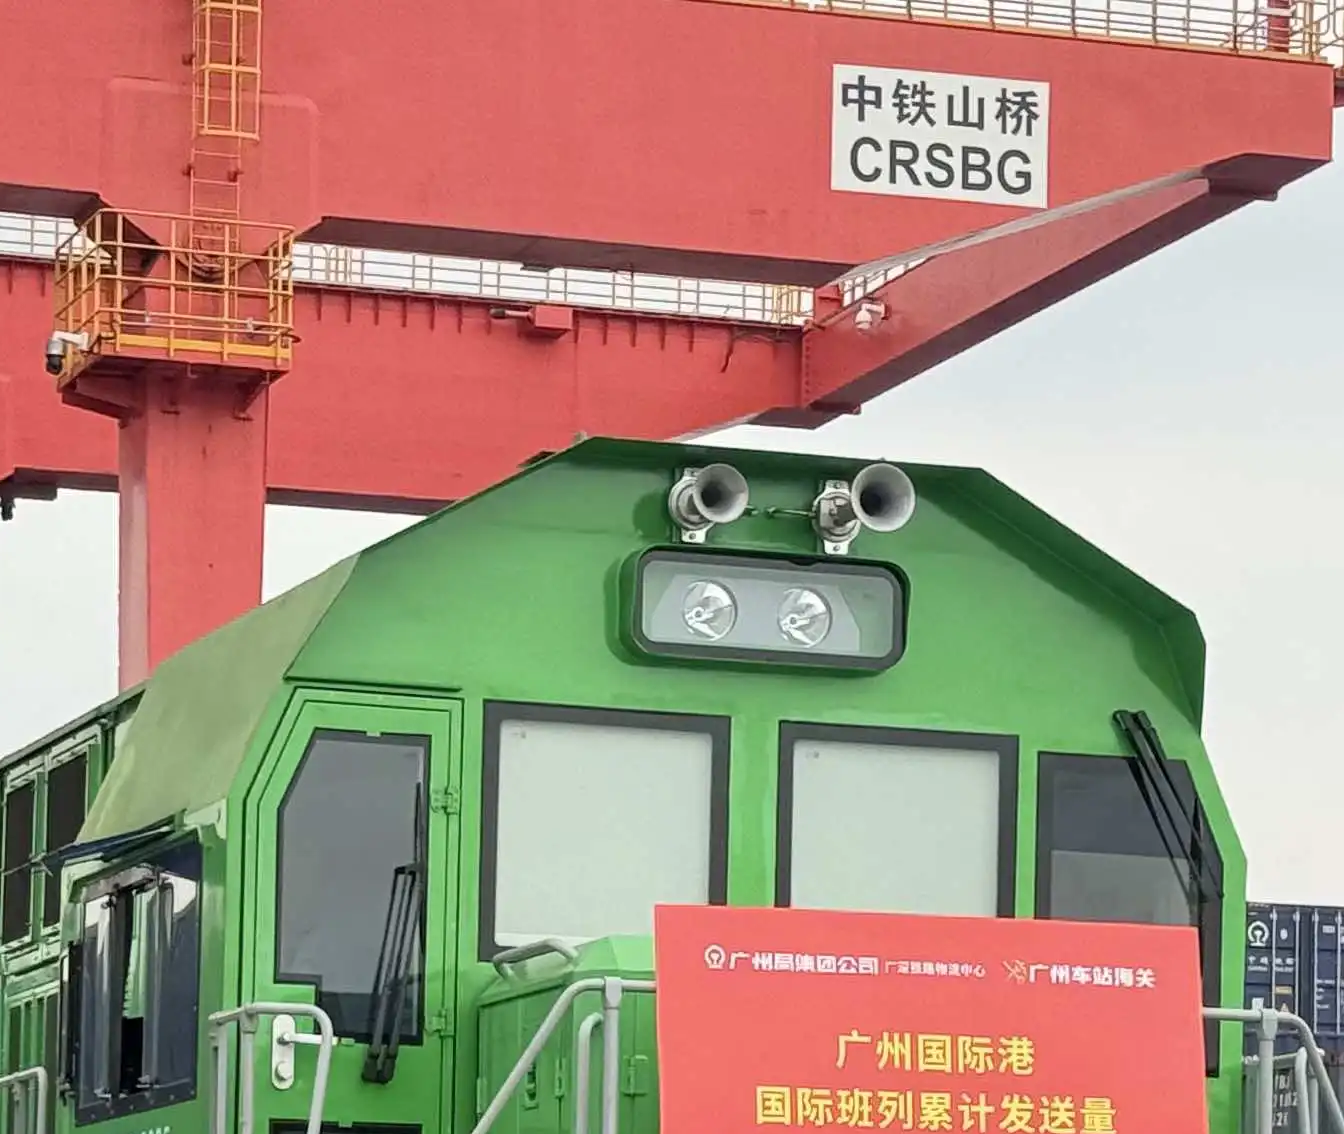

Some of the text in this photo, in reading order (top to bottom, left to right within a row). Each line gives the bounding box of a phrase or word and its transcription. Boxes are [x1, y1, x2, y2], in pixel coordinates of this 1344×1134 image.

[841, 75, 1040, 136] 中铁山桥
[850, 136, 1032, 195] CRSBG
[1029, 963, 1156, 988] 广州车站海关
[836, 1030, 1036, 1076] 广州国际港
